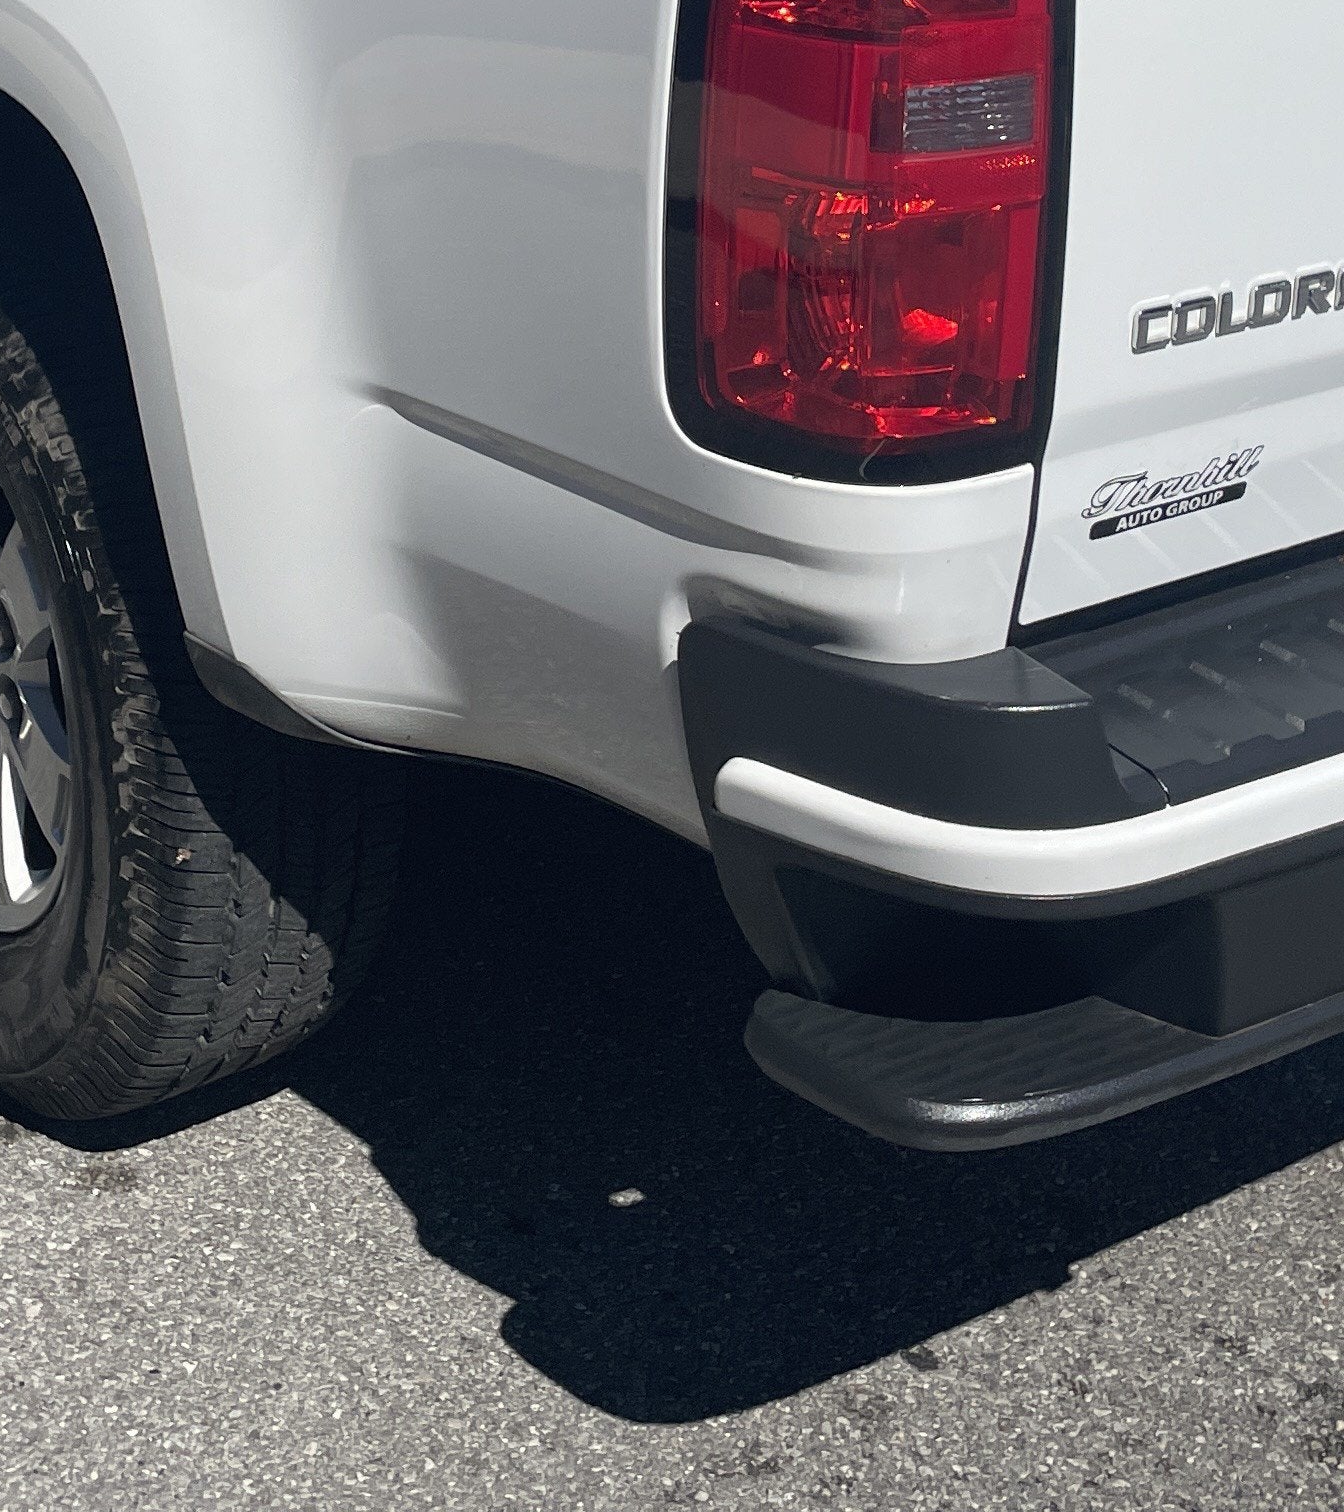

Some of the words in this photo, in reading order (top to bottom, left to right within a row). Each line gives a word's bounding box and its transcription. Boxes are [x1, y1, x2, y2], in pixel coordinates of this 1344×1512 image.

[1081, 444, 1264, 519] Thornhill
[1115, 506, 1163, 532] AUTO
[1166, 490, 1224, 517] GROUP
